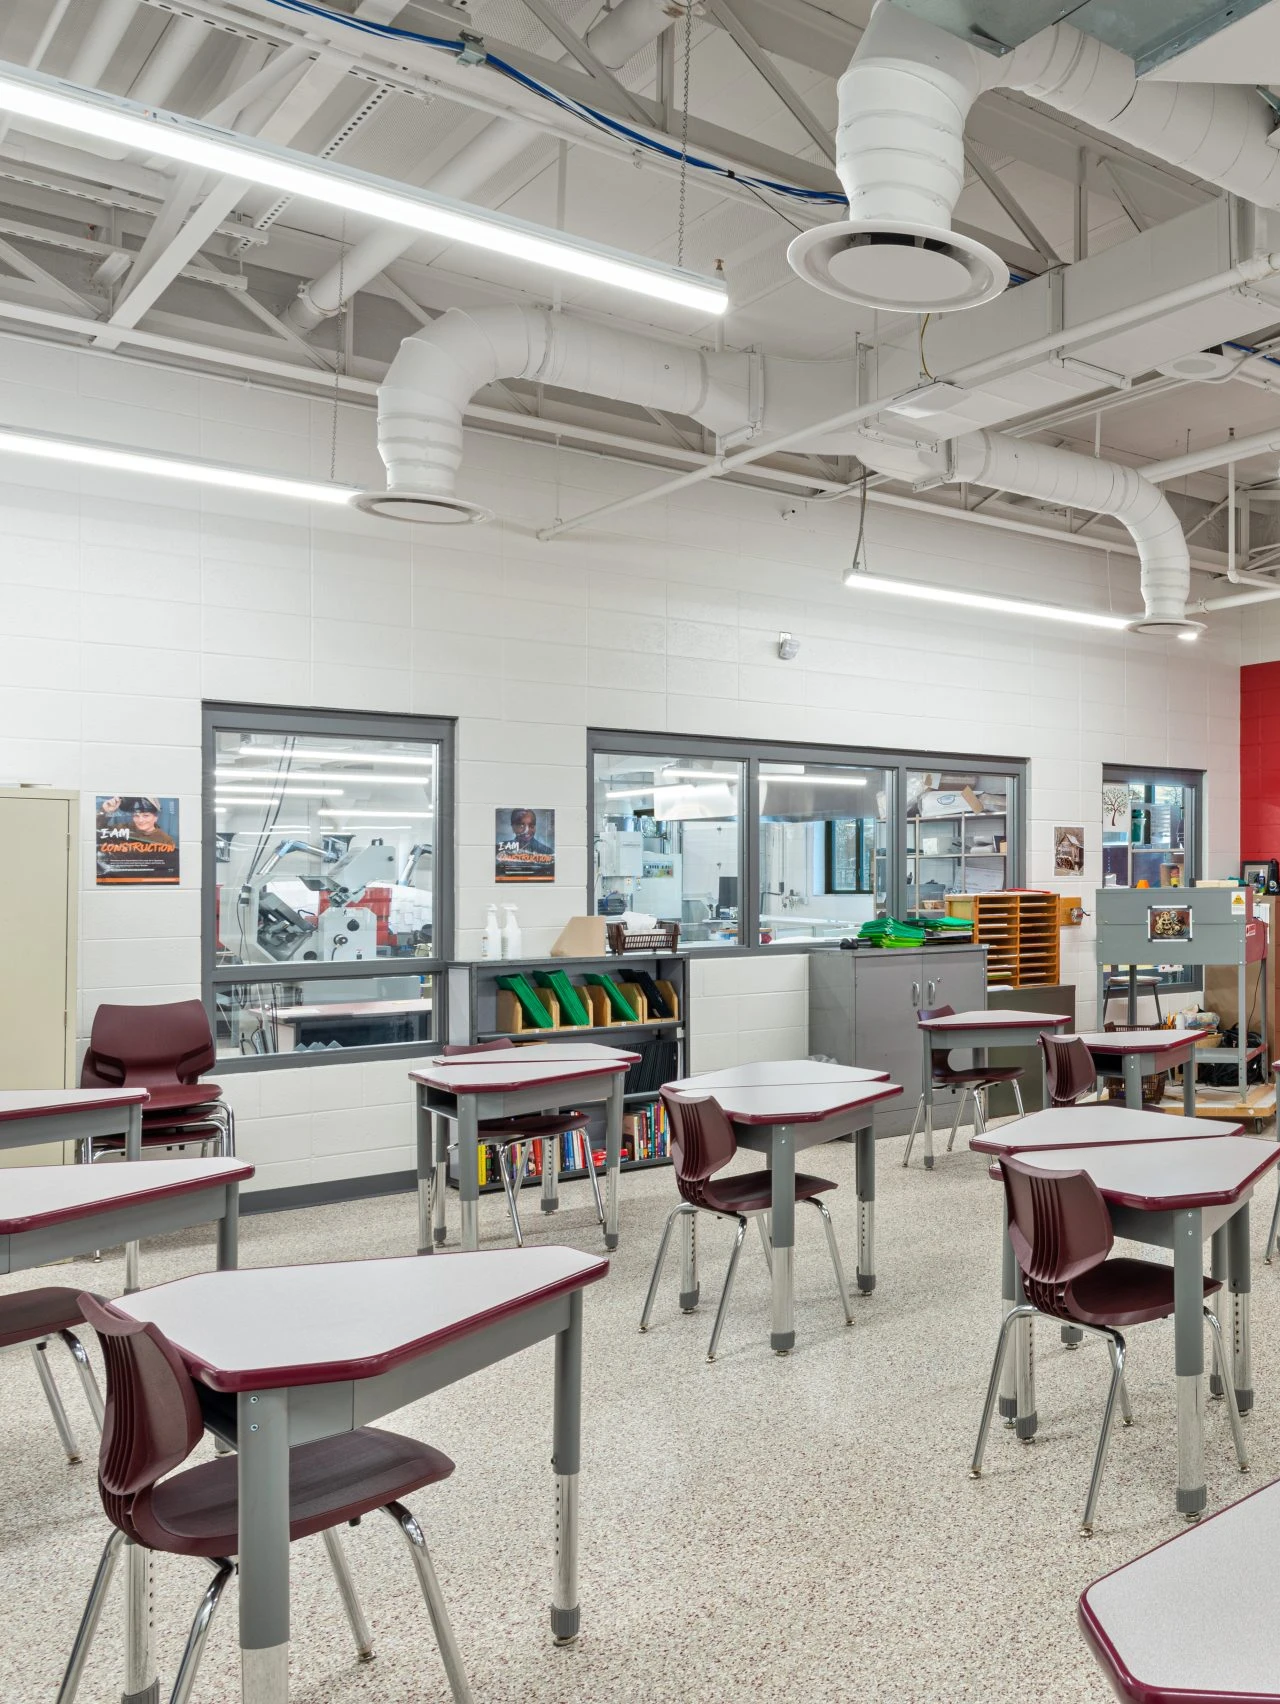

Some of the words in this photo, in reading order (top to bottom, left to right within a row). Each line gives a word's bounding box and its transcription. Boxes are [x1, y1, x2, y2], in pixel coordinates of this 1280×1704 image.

[100, 829, 109, 839] I
[110, 828, 130, 840] AM
[101, 841, 176, 853] CONSTRUCTION
[505, 841, 520, 851] AM
